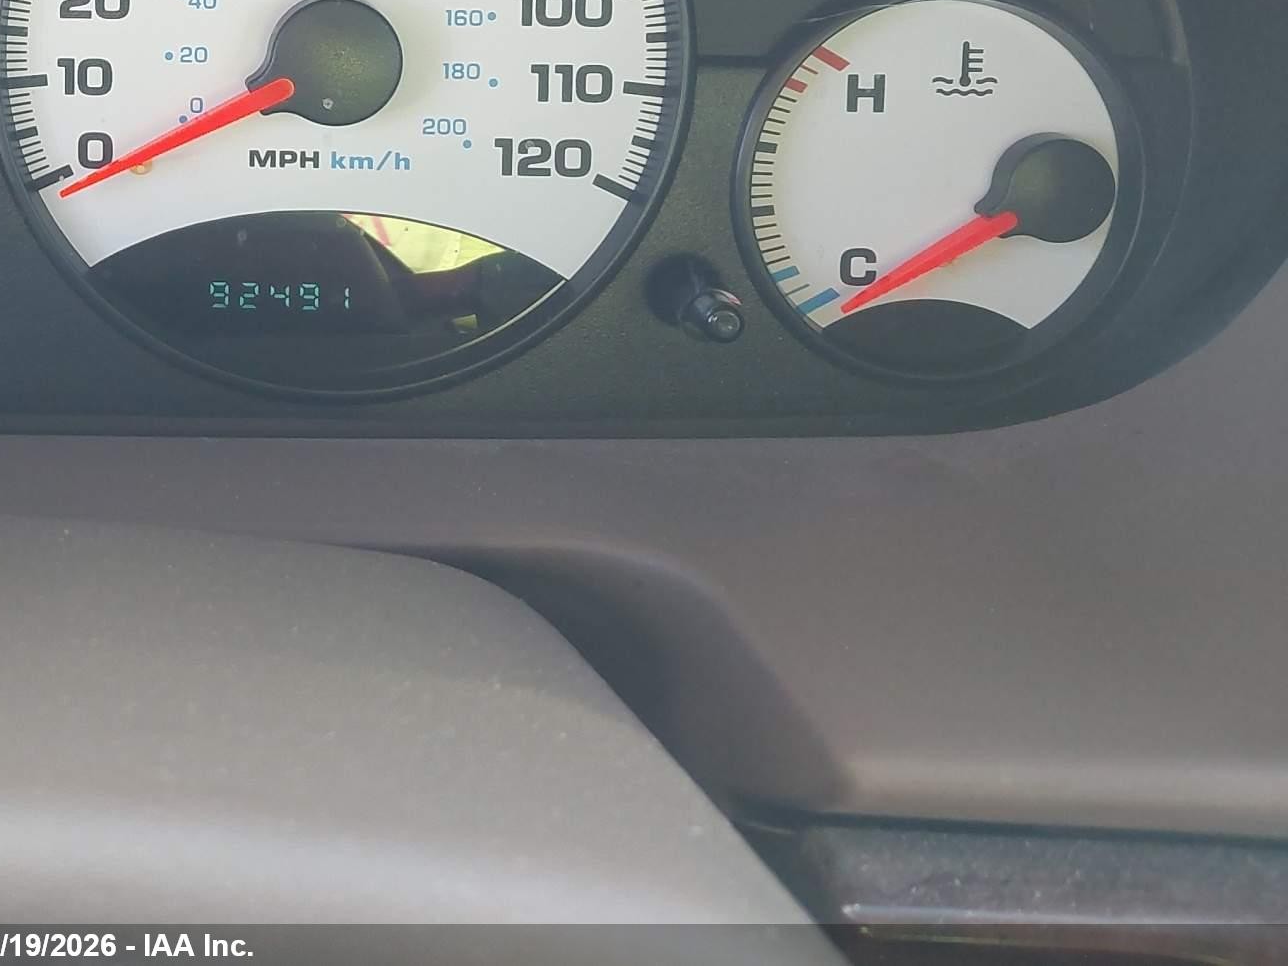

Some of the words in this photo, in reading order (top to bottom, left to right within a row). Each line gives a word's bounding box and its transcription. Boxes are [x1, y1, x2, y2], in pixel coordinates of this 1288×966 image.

[445, 9, 484, 27] 160
[179, 46, 208, 64] 20
[57, 57, 113, 96] 10
[443, 62, 480, 80] 180
[531, 63, 613, 103] 110
[189, 97, 204, 115] 0
[846, 74, 886, 113] H
[422, 117, 467, 136] 200
[77, 132, 113, 169] 0
[248, 149, 321, 170] MPH
[330, 150, 411, 172] km/h
[494, 137, 592, 178] 120
[839, 248, 877, 286] C
[209, 281, 351, 311] 92491
